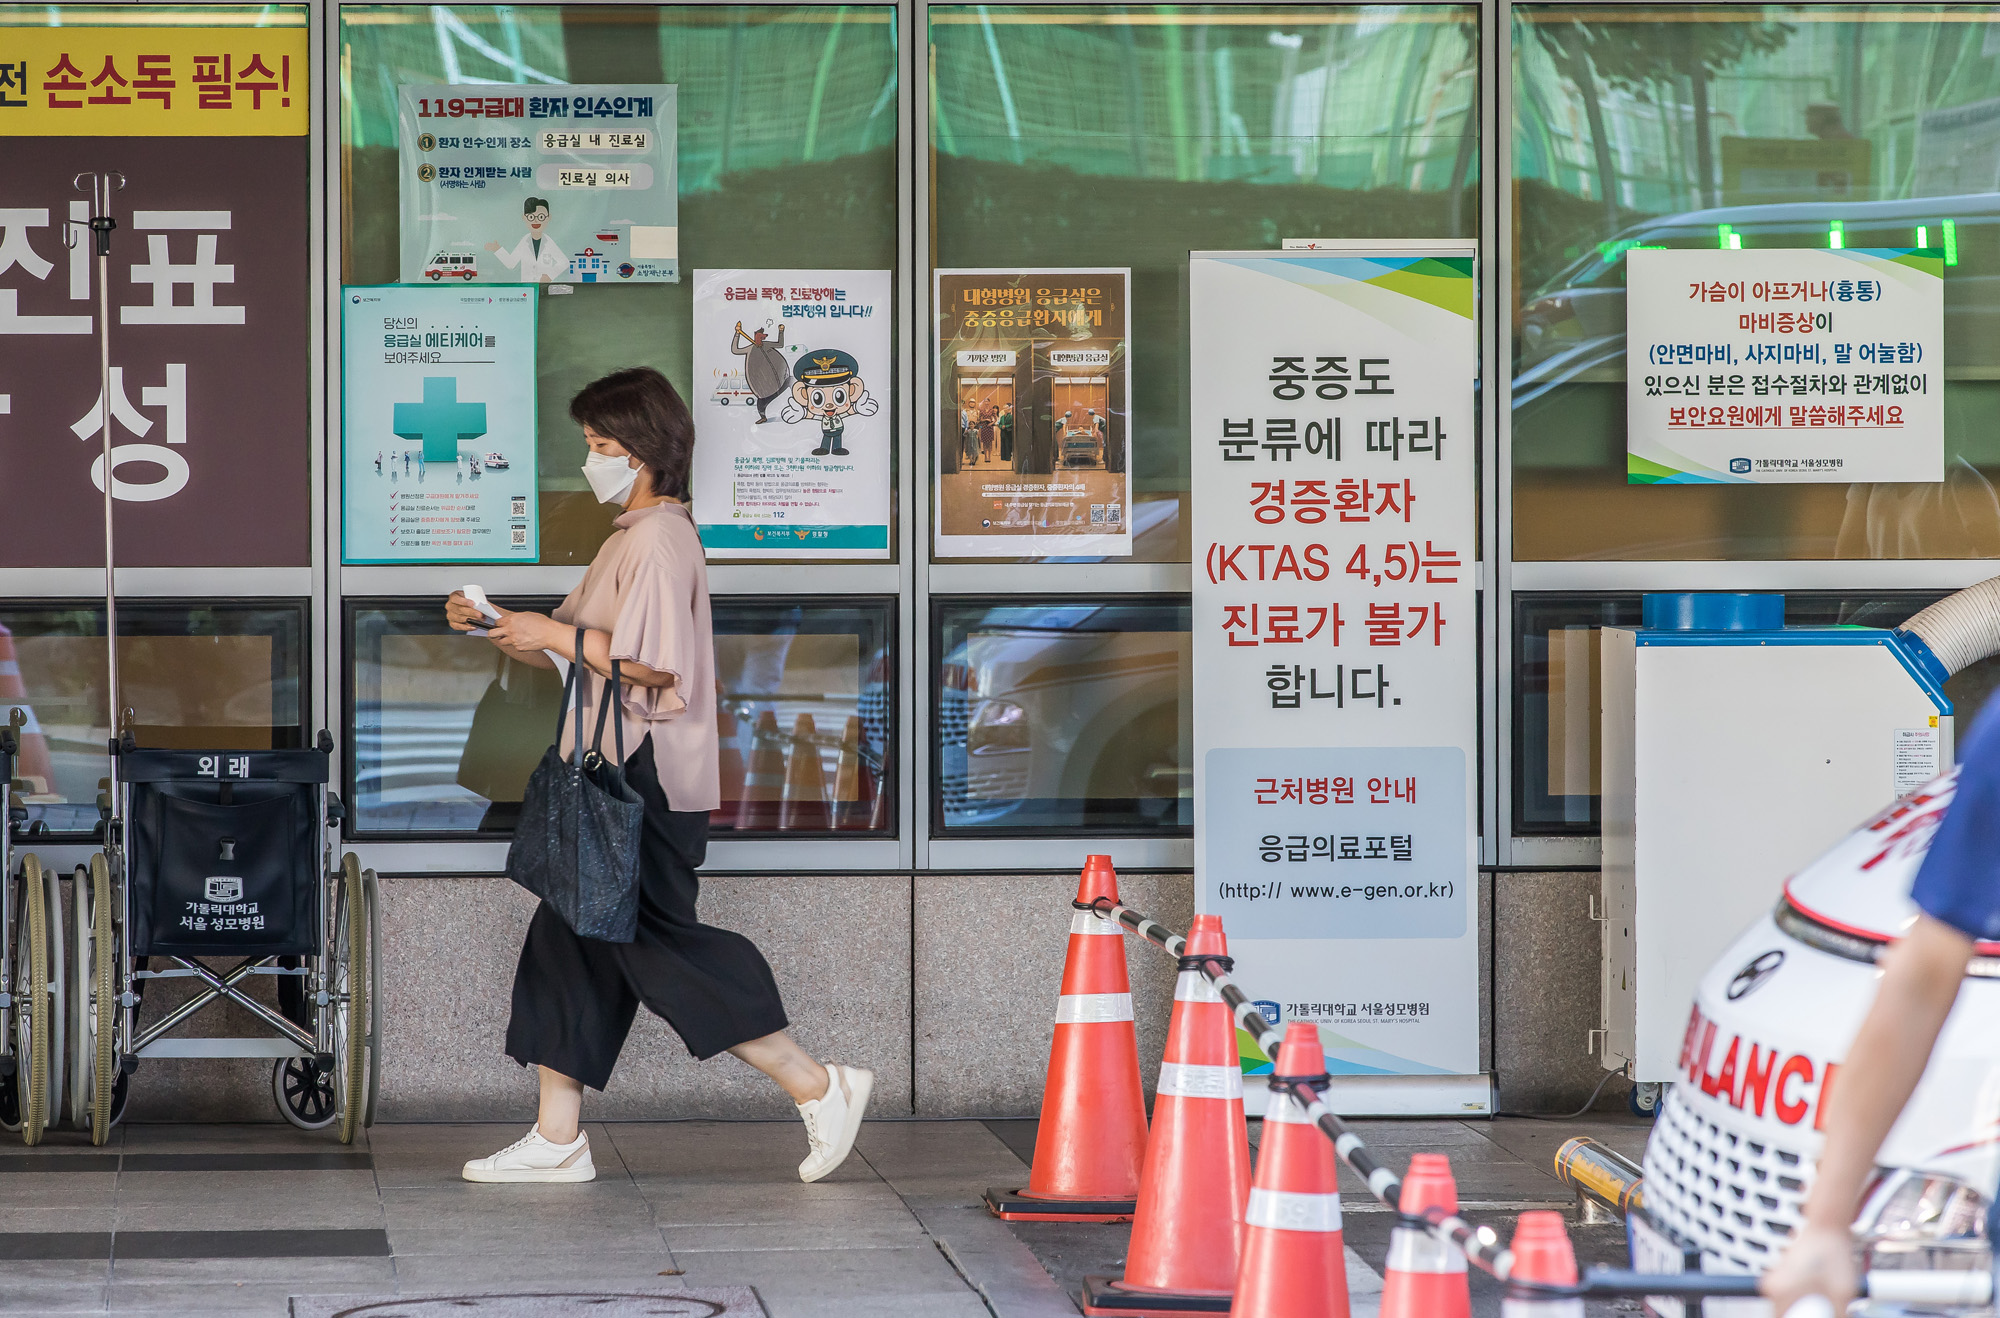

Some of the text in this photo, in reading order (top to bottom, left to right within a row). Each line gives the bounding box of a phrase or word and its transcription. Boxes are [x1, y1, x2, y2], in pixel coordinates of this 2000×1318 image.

[0, 53, 292, 110] 전 손소독 필수!
[418, 97, 654, 119] 119구급대 환자 인수인계
[438, 136, 460, 150] 환자
[510, 136, 532, 150] 장소
[543, 133, 646, 148] 응급실 내 진료실
[438, 166, 461, 179] 환자
[463, 166, 508, 179] 인계받는
[510, 166, 533, 179] 사람
[560, 171, 630, 186] 진료실 의사
[439, 179, 487, 190] (서명하는 사람)
[724, 286, 846, 301] 응급실 폭행, 진료방해는
[963, 287, 1103, 305] 대형병원 응급실은
[1689, 279, 1882, 303] 가슴이 아프거나(흉통)
[781, 304, 873, 318] 범죄행위 입니다!!
[963, 310, 1102, 328] 중증응급환자에게
[383, 317, 418, 330] 당신의
[1738, 311, 1833, 334] 마비증상이
[384, 332, 496, 348] 응급실 에티케어를
[384, 351, 442, 364] 보여주세요
[966, 354, 1007, 363] 가까운 병원
[1052, 354, 1108, 362] 대형병원 응급실
[1649, 342, 1923, 367] (안면마비, 사지마비, 말 어눌함)
[1268, 356, 1395, 400] 중증도
[1644, 374, 1927, 397] 있으신 분은 접수절차와 관계없이
[1667, 404, 1904, 428] 보안요원에게 말씀해주세요
[1218, 416, 1447, 462] 분류에 따라
[734, 456, 751, 464] 응급실
[1754, 459, 1844, 468] 가톨릭대학교 서울성모병원
[1249, 478, 1416, 525] 경증환자
[1206, 540, 1462, 588] (KTAS 4,5)는
[1221, 602, 1447, 647] 진료가 불가
[1265, 664, 1402, 709] 합니다.
[1254, 776, 1417, 805] 근처병원 안내
[1258, 834, 1413, 863] 응급의료포털
[1219, 881, 1454, 902] (http:// www.e-gen.or.kr)
[185, 901, 260, 916] 가톨릭대학교
[179, 915, 265, 932] 서울 성모병원
[1286, 1002, 1357, 1016] 가톨릭대학교
[1360, 1002, 1430, 1016] 서울성모병원
